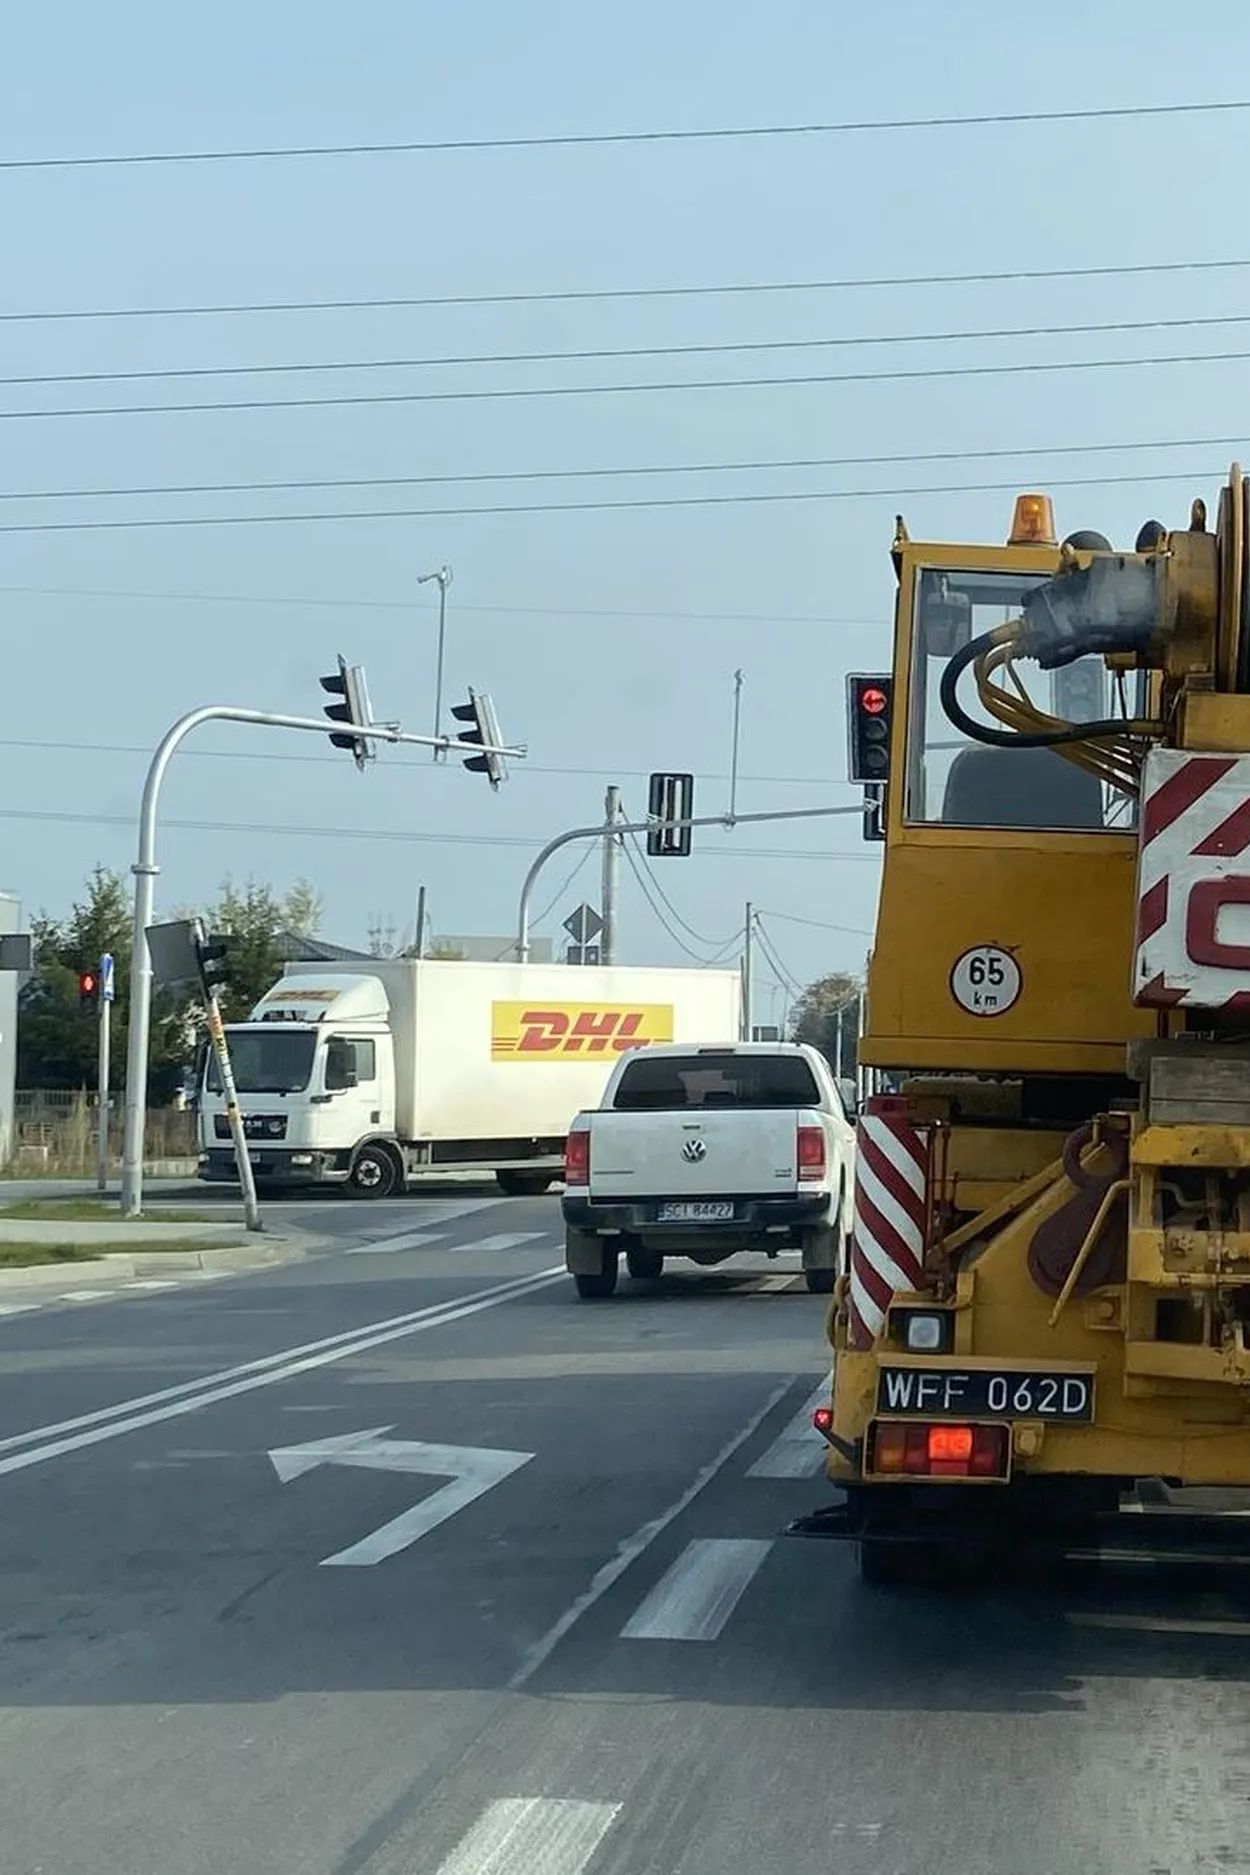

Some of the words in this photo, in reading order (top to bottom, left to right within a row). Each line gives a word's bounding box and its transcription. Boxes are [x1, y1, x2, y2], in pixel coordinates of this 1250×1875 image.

[969, 956, 1005, 986] 65
[973, 991, 998, 1006] km
[517, 1011, 651, 1052] DHL
[886, 1372, 969, 1409] WFF
[987, 1377, 1088, 1414] 062D
